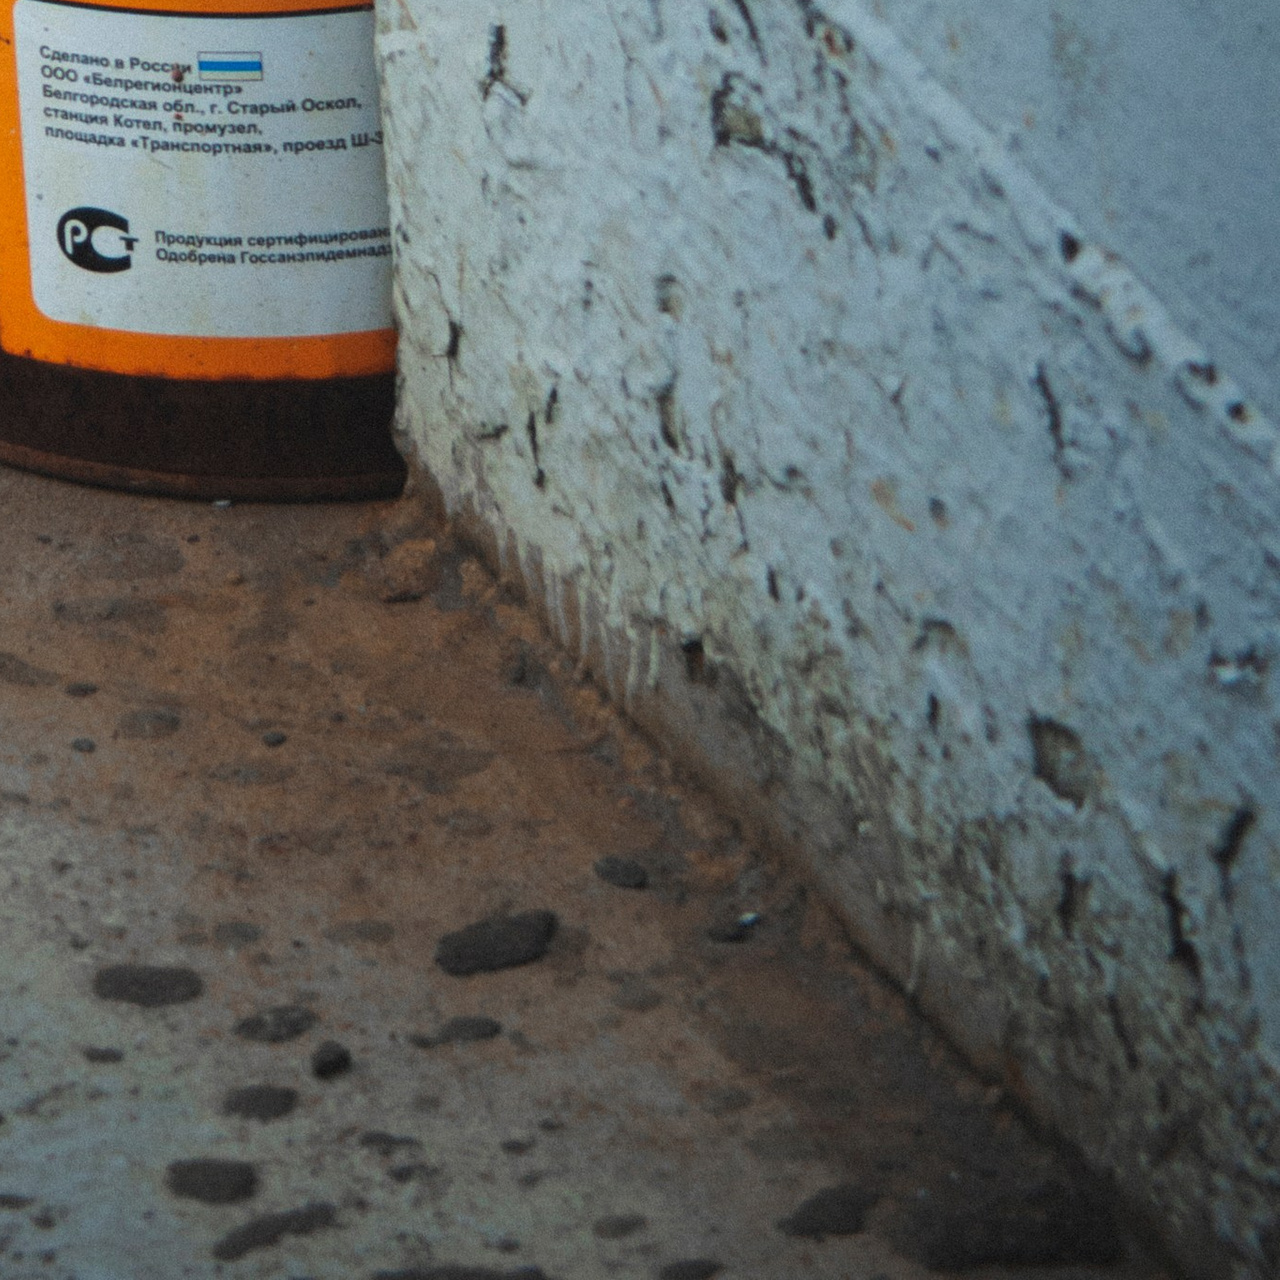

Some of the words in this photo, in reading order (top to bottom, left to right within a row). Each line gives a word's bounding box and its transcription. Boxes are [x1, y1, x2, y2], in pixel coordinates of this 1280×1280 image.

[39, 45, 110, 67] Сделано
[115, 58, 124, 70] в
[129, 57, 192, 74] России
[40, 65, 78, 82] ООО
[83, 72, 243, 97] «Белрегионцентр»
[42, 84, 158, 111] Белгородская
[162, 100, 206, 116] обл.,
[209, 103, 223, 115] г.
[227, 100, 296, 117] Старый
[301, 96, 363, 111] Оскол,
[43, 106, 108, 124] станция
[114, 114, 168, 132] Котел,
[172, 121, 263, 137] промузел,
[45, 125, 125, 148] площадка
[130, 135, 278, 156] «Транспортная»,
[282, 135, 347, 154] проезд
[154, 230, 243, 249] Продукция
[156, 249, 236, 265] Одобрена
